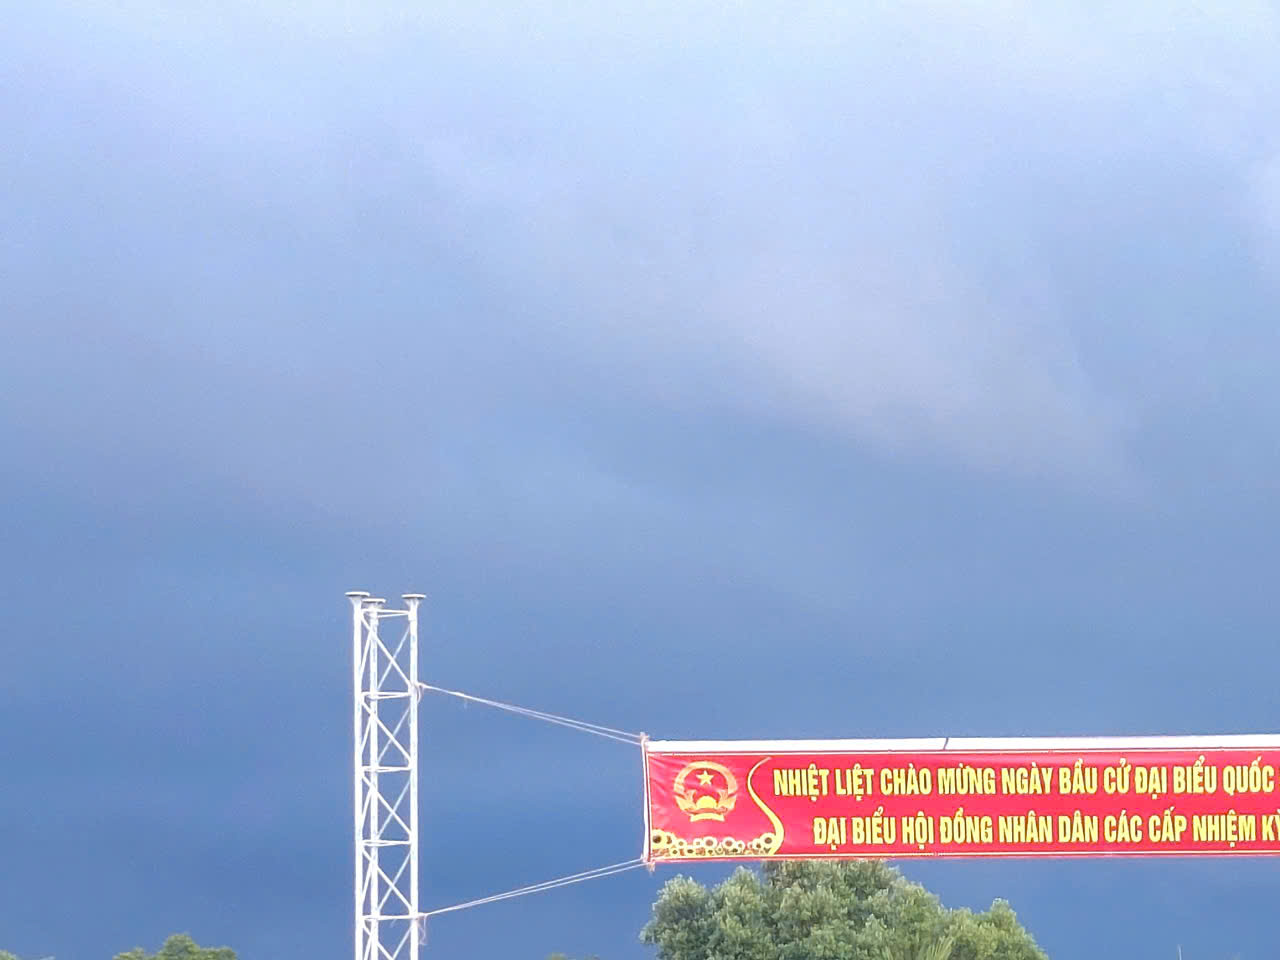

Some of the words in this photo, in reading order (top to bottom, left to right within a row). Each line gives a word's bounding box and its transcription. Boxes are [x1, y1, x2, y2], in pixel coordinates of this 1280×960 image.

[773, 763, 830, 802] NHIỆT
[834, 762, 875, 802] LIỆT
[880, 762, 933, 796] CHÀO
[937, 762, 997, 796] MỪNG
[1001, 761, 1053, 796] NGÀY
[1059, 758, 1098, 795] BẦU
[1103, 757, 1132, 795] CỬ
[1135, 766, 1168, 800] ĐẠI
[1173, 754, 1218, 794] BIỂU
[1223, 755, 1275, 797] QUỐC
[812, 816, 847, 851] ĐẠI
[851, 804, 897, 845] BIỂU
[901, 810, 935, 851] HỘI
[939, 804, 993, 845] ĐỒNG
[998, 809, 1053, 844] NHÂN
[1058, 808, 1099, 844] DÂN
[1103, 809, 1143, 843] CÁC
[1148, 805, 1188, 843] CẤP
[1192, 809, 1257, 848] NHIỆM
